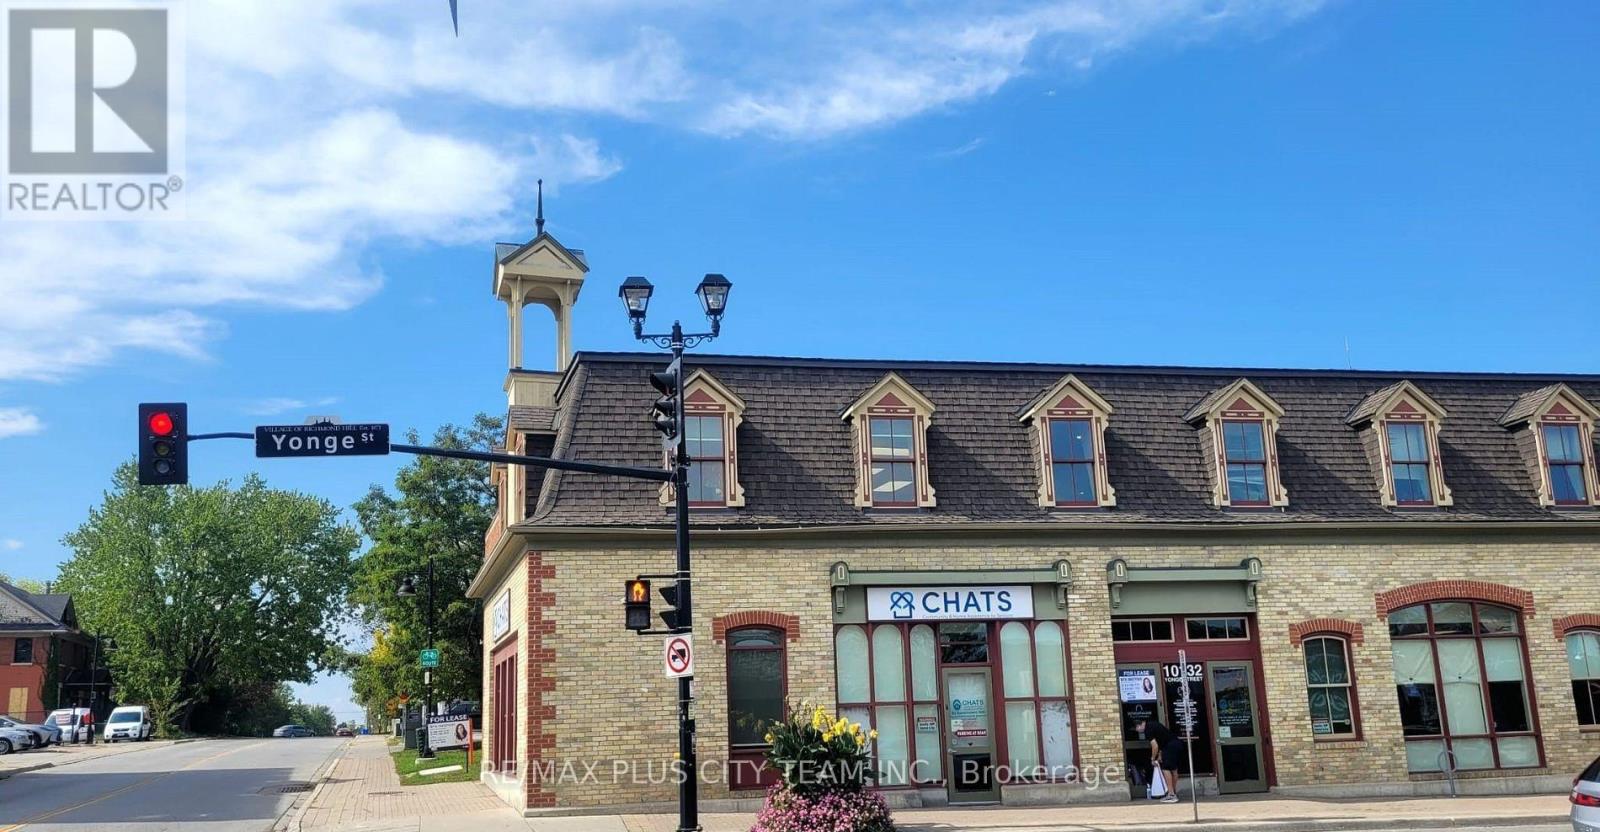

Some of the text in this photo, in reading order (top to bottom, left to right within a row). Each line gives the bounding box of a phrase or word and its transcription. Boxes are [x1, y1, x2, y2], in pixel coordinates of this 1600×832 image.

[271, 432, 374, 454] Yonge St
[922, 590, 1012, 613] CHATS
